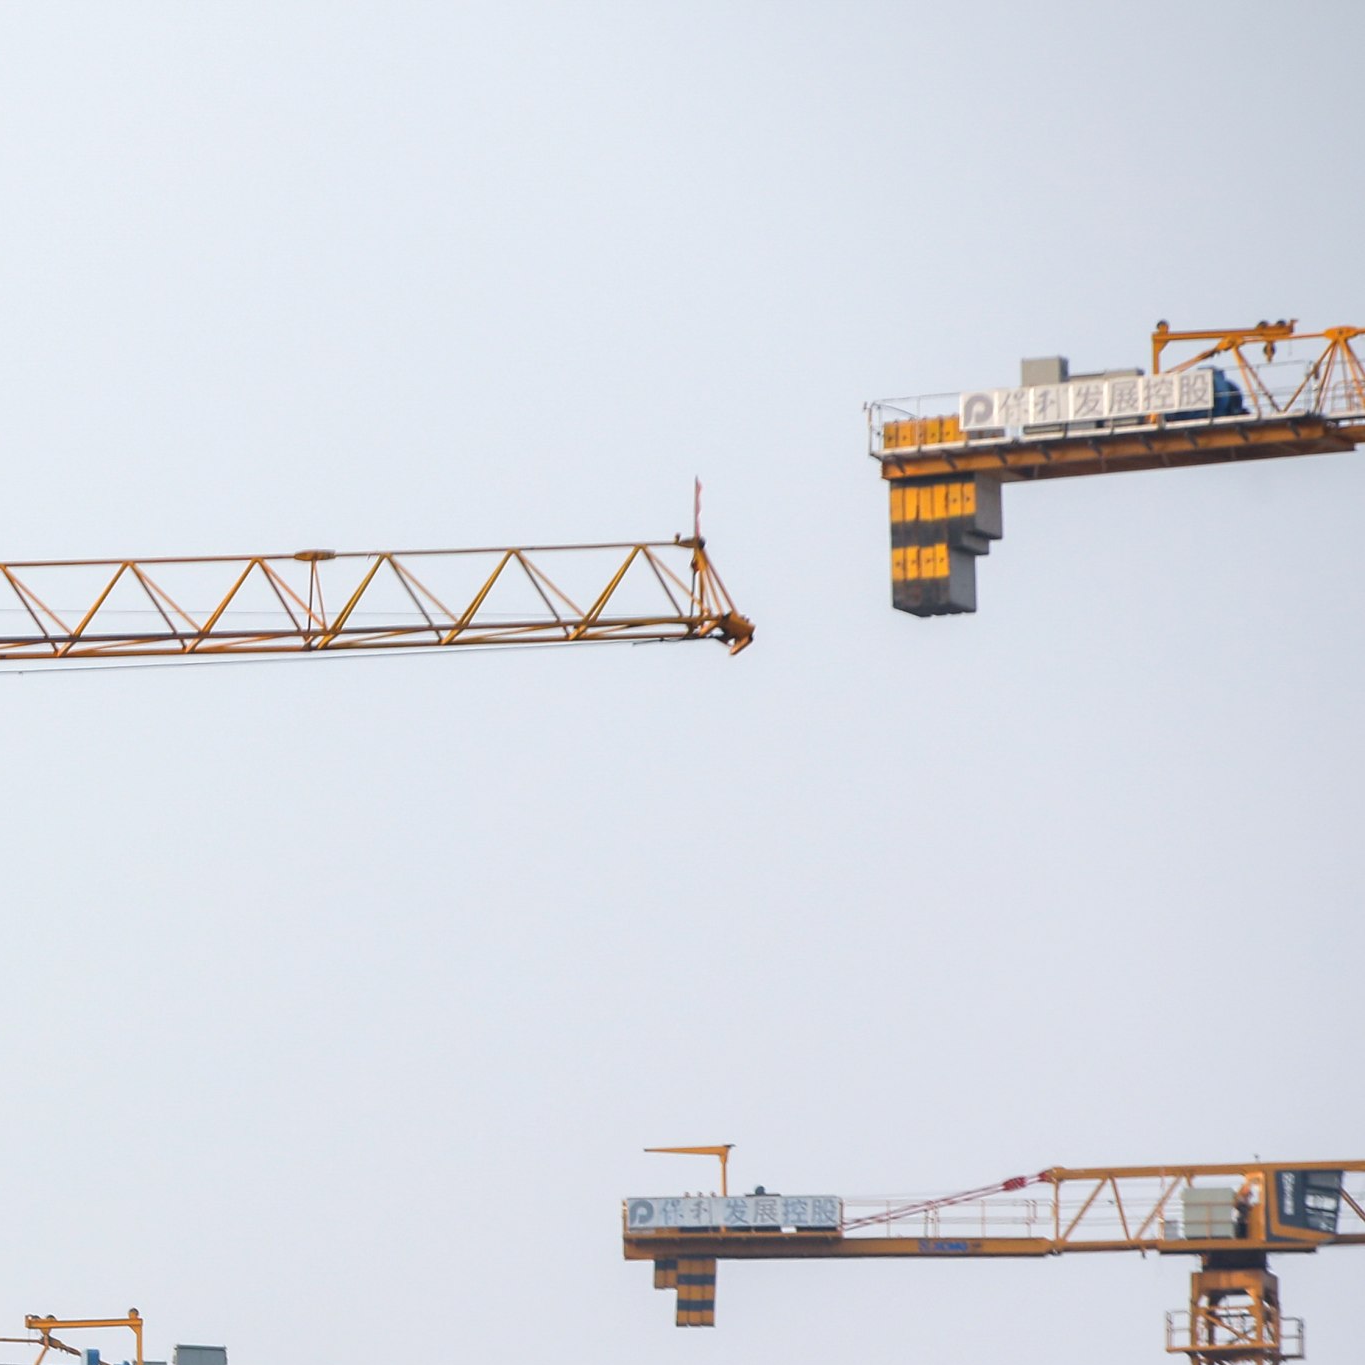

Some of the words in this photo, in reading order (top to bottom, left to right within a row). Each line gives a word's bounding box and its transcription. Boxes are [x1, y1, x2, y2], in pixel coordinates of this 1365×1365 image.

[998, 372, 1209, 427] 保利发展控股
[659, 1197, 839, 1225] 保利发展控股
